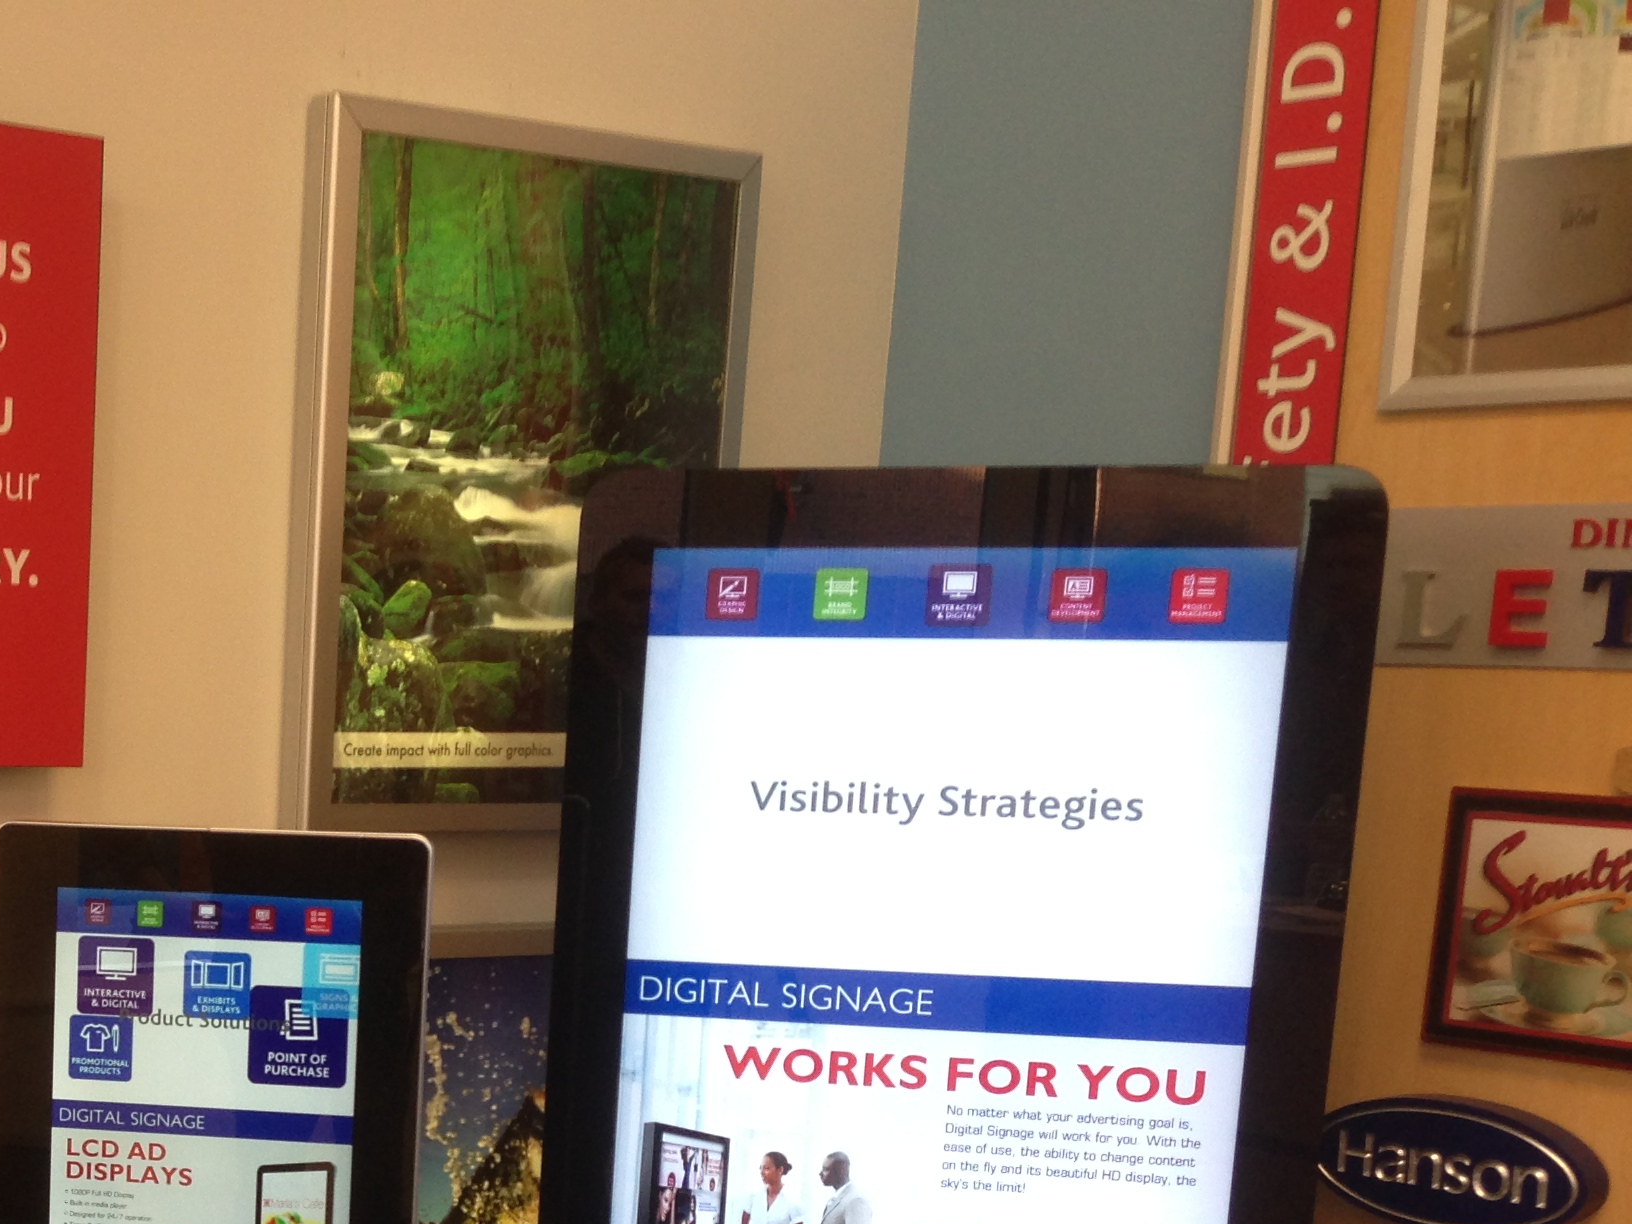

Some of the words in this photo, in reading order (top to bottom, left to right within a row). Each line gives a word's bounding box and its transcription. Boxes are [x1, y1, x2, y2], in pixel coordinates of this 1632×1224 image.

[1274, 7, 1353, 170] I.D.
[1269, 199, 1333, 272] &
[1245, 307, 1336, 464] ety
[343, 742, 382, 757] Create
[386, 744, 424, 760] impact
[428, 743, 451, 757] with
[454, 742, 471, 756] full
[475, 742, 502, 756] color
[749, 780, 925, 826] Visibility
[938, 785, 1145, 830] Strategies
[83, 987, 147, 1000] INTERACTIVE
[91, 999, 99, 1008] &
[101, 998, 139, 1010] DIGITAL
[638, 975, 769, 1008] DIGITAL
[781, 982, 934, 1017] SIGNAGE
[263, 1064, 330, 1079] PURCHASE
[267, 1051, 306, 1064] POINT
[310, 1053, 327, 1065] OF
[723, 1043, 928, 1091] WORKS
[946, 1056, 1058, 1099] FOR
[1077, 1062, 1207, 1107] YOU
[58, 1107, 125, 1125] DIGITAL
[130, 1111, 205, 1130] SIGNAGE
[946, 1104, 963, 1117] No
[967, 1106, 1010, 1119] matter
[1012, 1109, 1042, 1121] what
[1046, 1112, 1073, 1124] your
[1076, 1113, 1145, 1130] advertising
[1148, 1117, 1175, 1131] goal
[66, 1137, 120, 1159] LCD
[126, 1142, 167, 1162] AD
[945, 1122, 983, 1137] Digital
[986, 1125, 1035, 1141] Signage
[1038, 1129, 1058, 1141] will
[1061, 1131, 1091, 1143] work
[1094, 1131, 1112, 1144] for
[1146, 1135, 1177, 1148] With
[1180, 1138, 1202, 1150] the
[66, 1160, 193, 1187] DISPLAYS
[1337, 1128, 1550, 1209] Hanson
